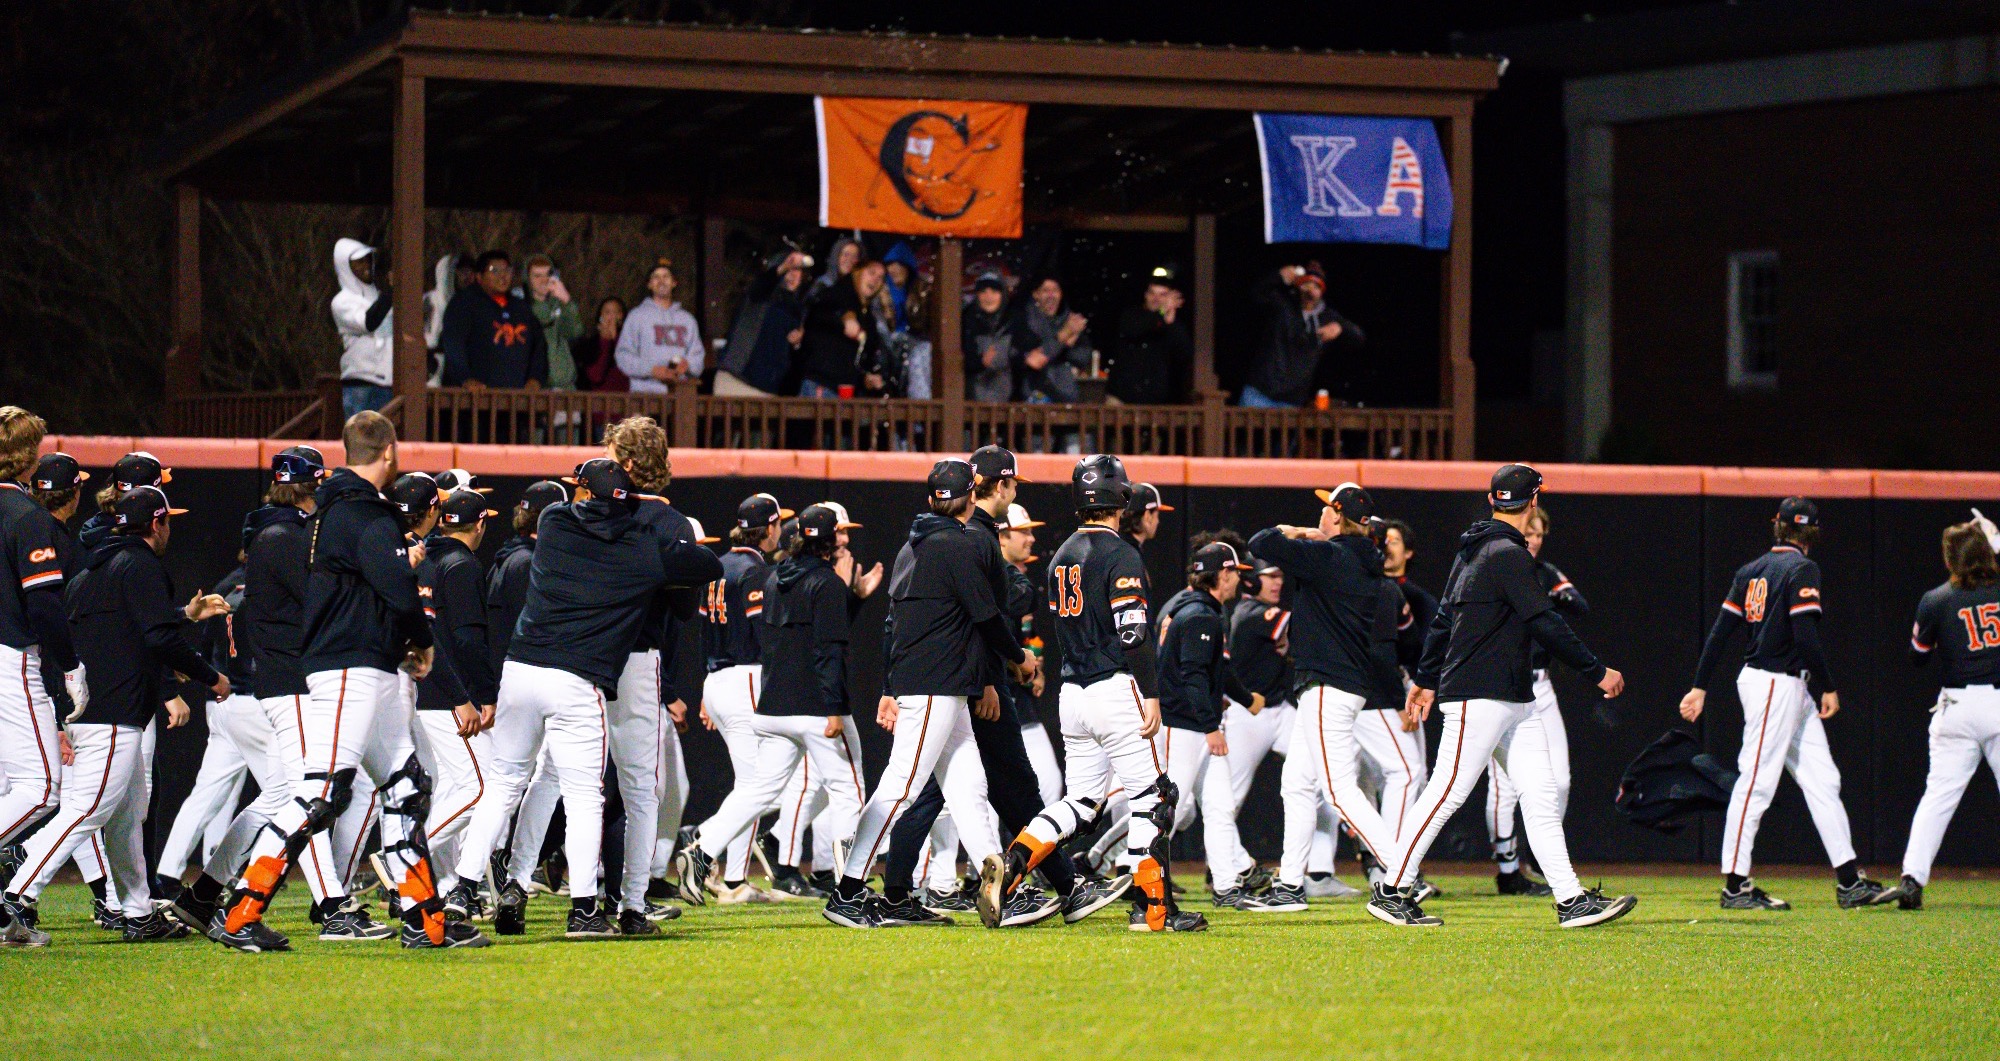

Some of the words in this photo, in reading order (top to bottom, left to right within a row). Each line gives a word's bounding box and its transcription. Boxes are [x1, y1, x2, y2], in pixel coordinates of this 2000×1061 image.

[707, 578, 728, 624] 44
[1055, 564, 1084, 617] 13
[1115, 577, 1142, 589] CAA
[1958, 602, 2000, 651] 15
